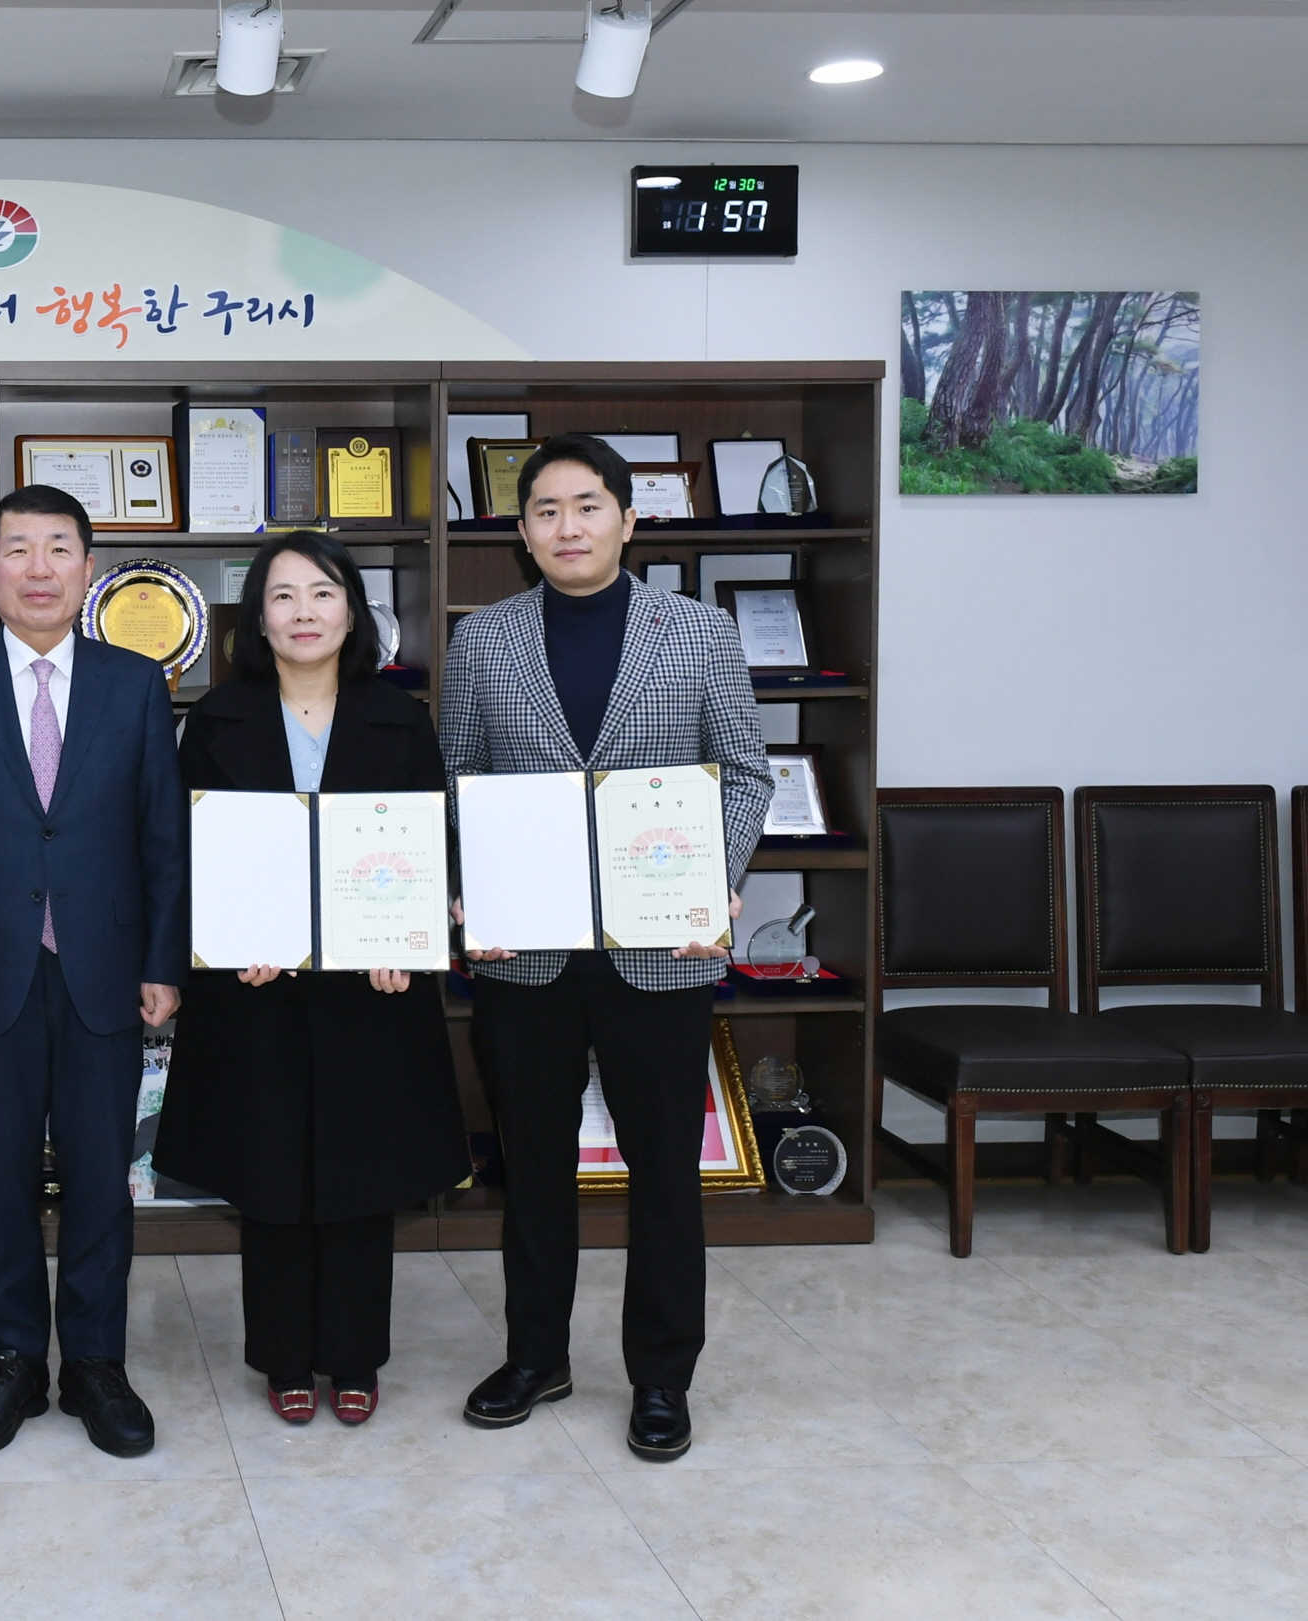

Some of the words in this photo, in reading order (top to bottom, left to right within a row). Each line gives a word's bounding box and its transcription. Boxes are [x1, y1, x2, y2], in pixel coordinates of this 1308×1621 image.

[714, 178, 736, 191] 12월
[738, 178, 765, 191] 30일
[36, 283, 189, 349] 행복한
[202, 290, 315, 336] 구리시
